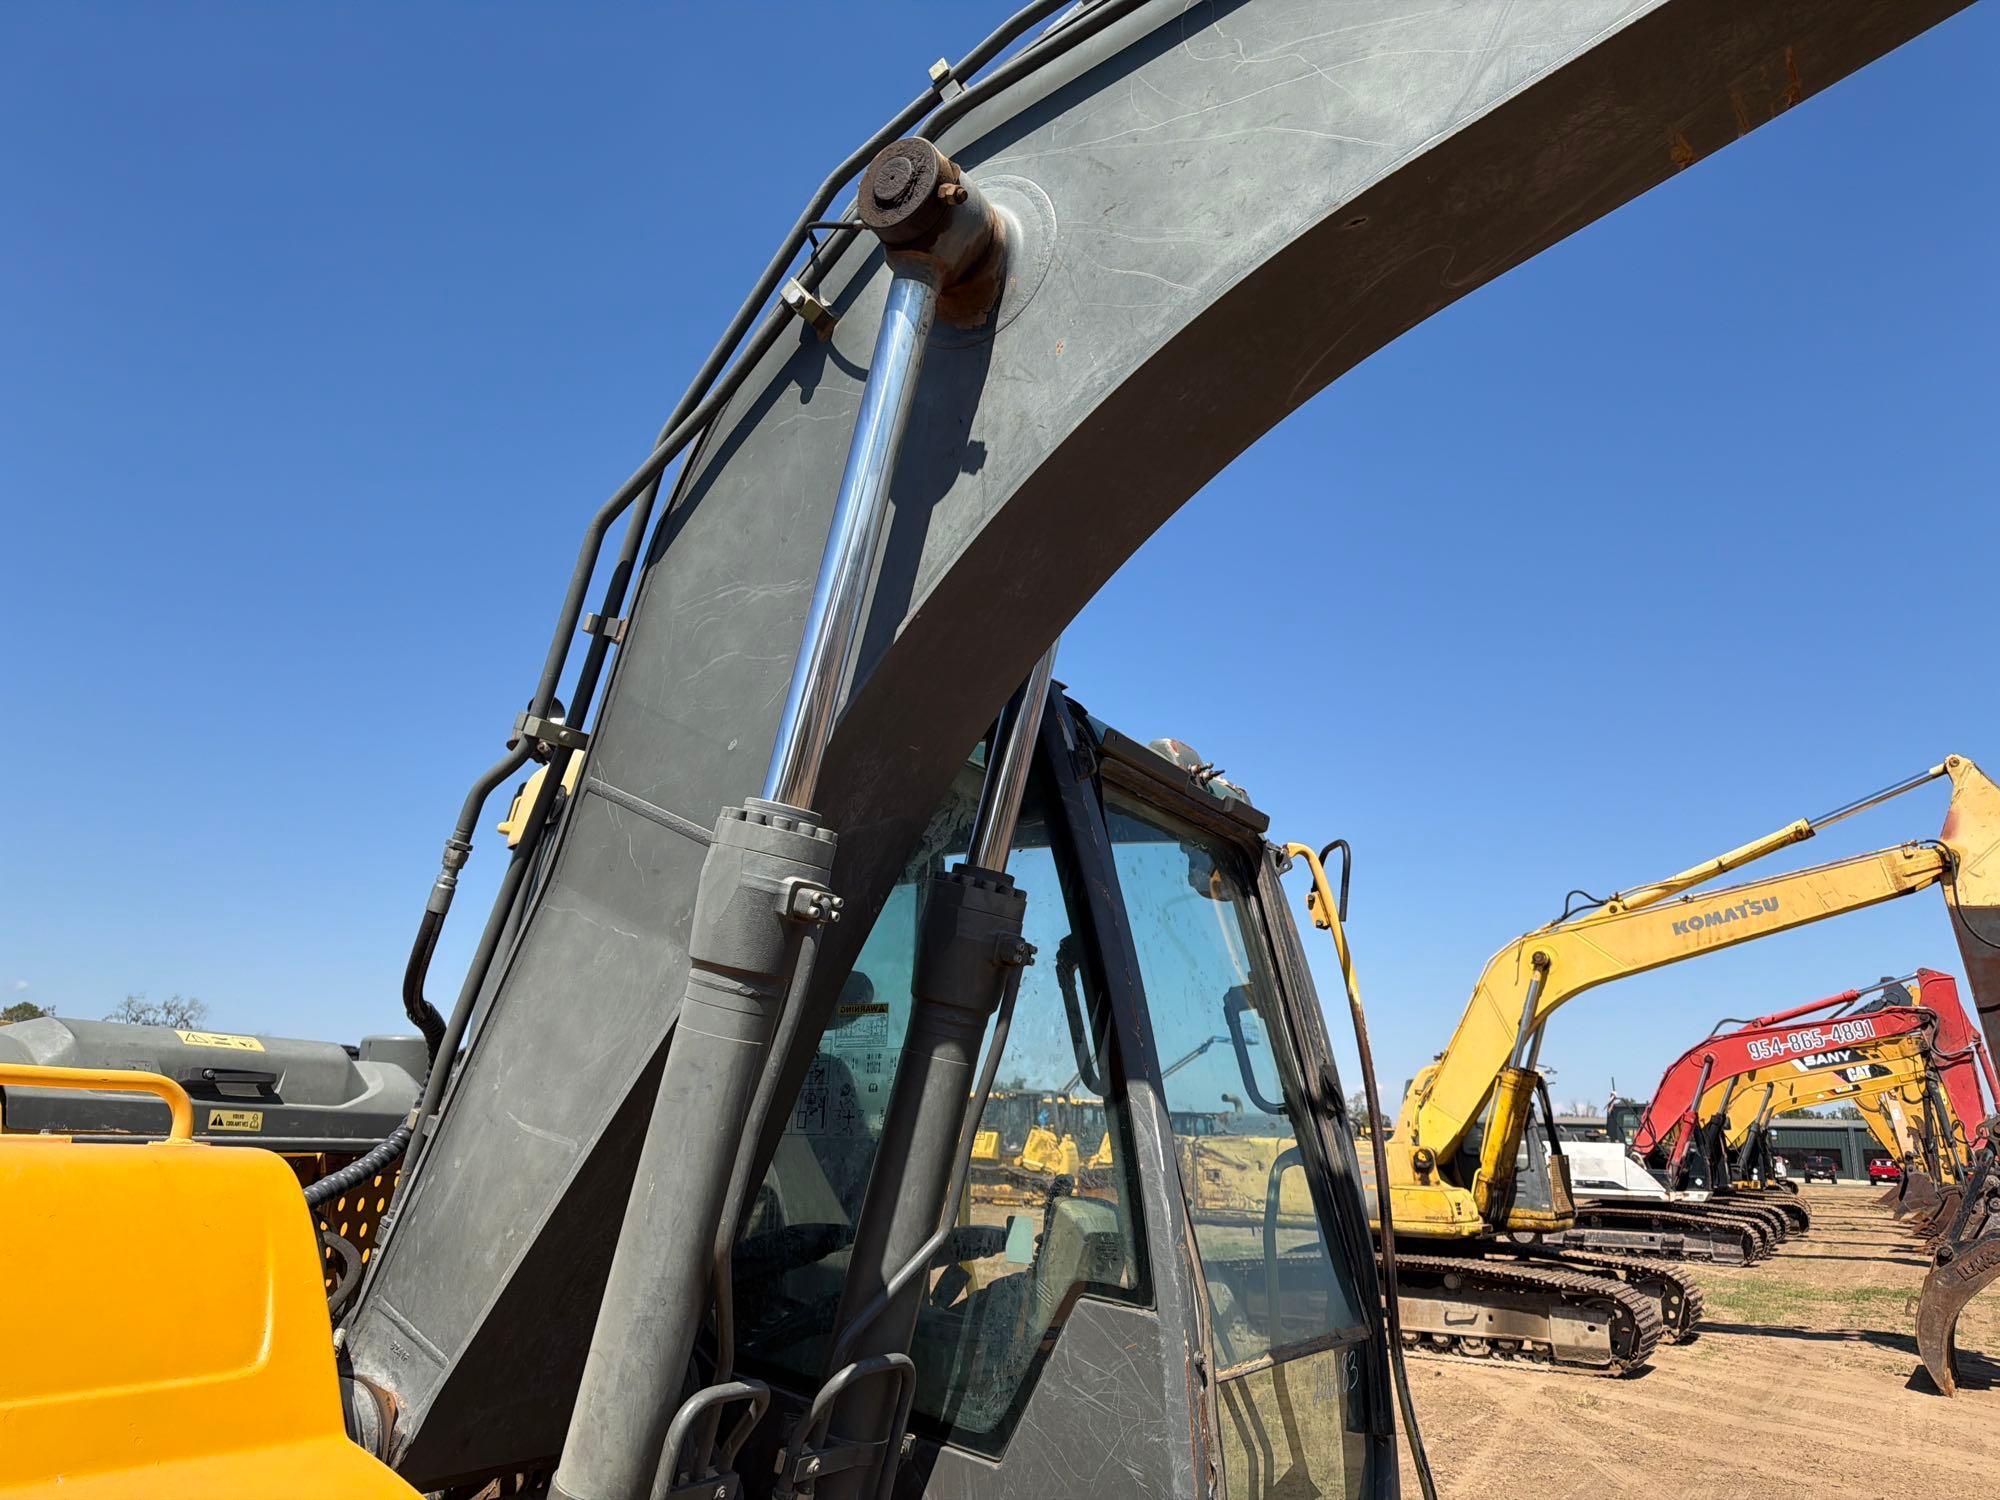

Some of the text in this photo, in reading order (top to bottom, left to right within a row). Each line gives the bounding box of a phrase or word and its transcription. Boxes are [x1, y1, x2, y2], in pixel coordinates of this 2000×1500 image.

[1672, 896, 1779, 936] KOMATSU
[1747, 1018, 1876, 1060] 954-865-4891
[1803, 1050, 1851, 1066] SANY
[1846, 1065, 1872, 1082] CAT
